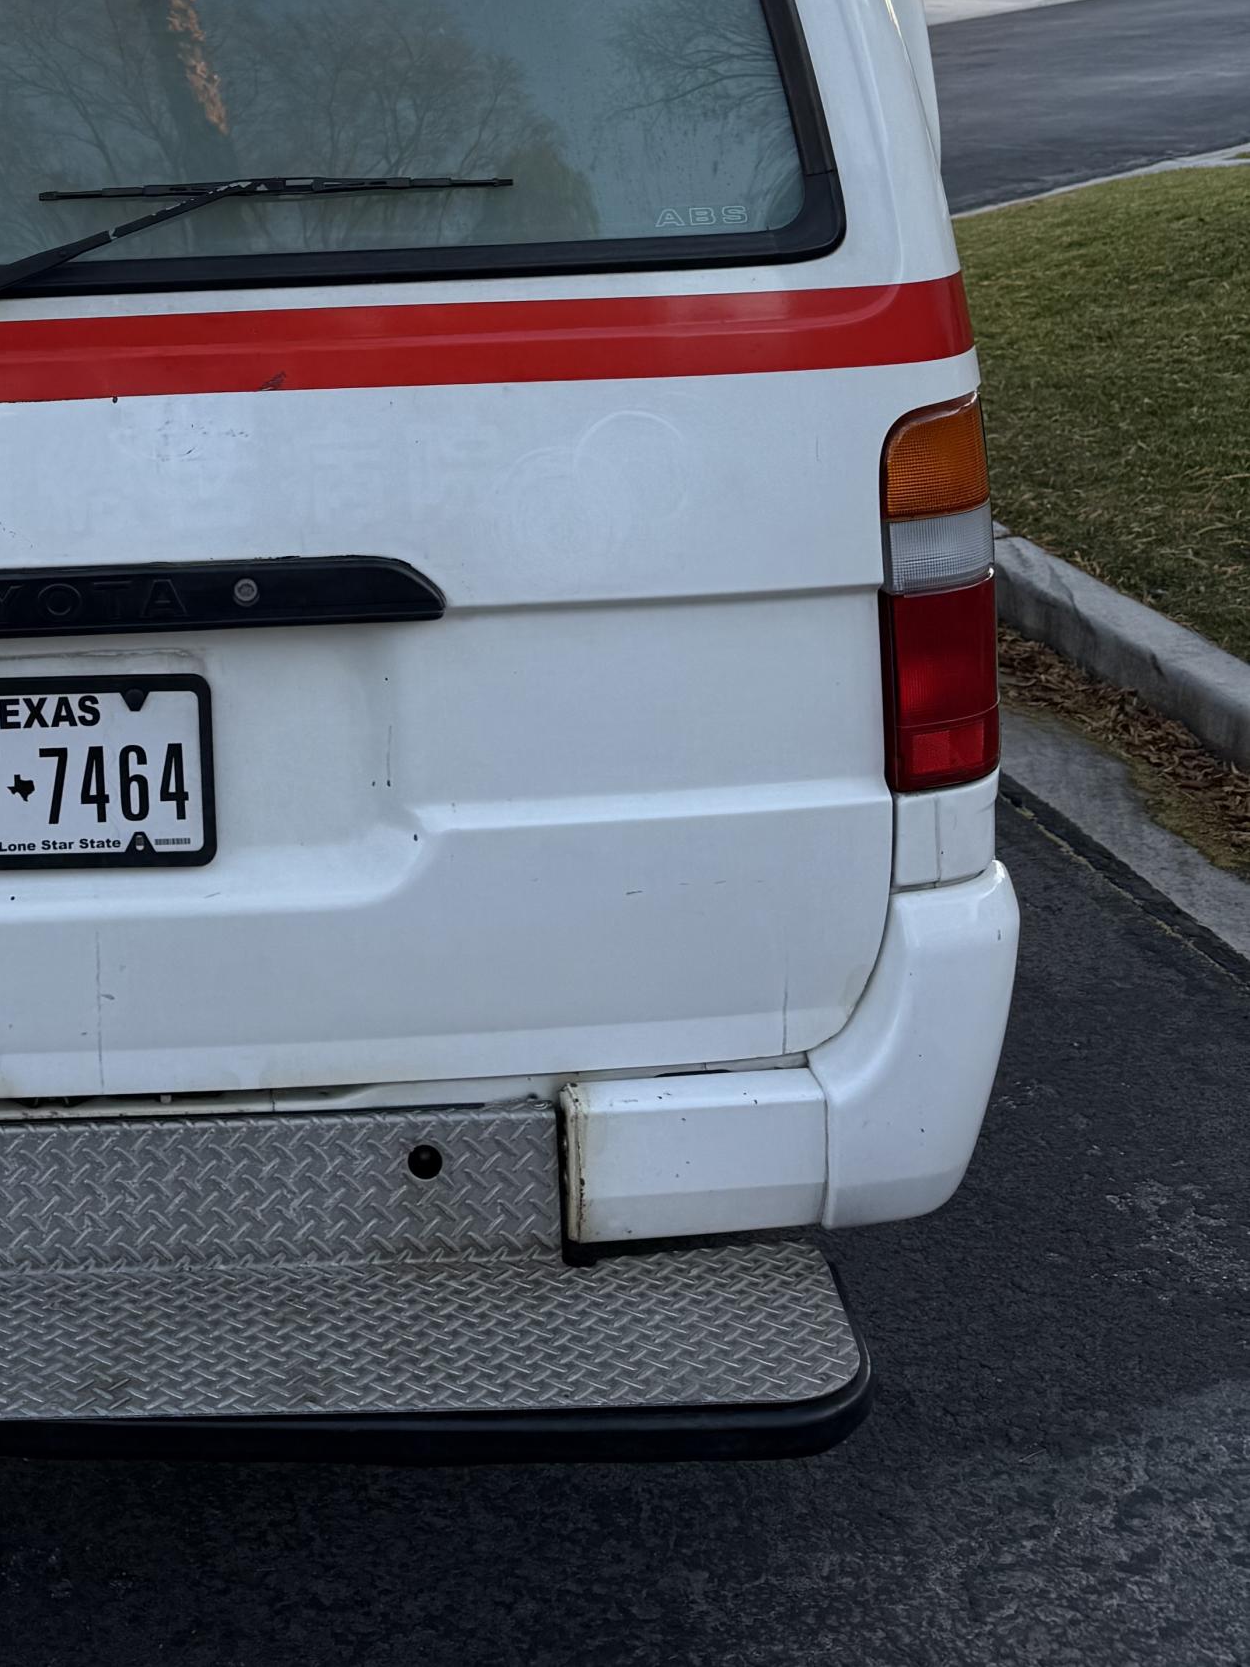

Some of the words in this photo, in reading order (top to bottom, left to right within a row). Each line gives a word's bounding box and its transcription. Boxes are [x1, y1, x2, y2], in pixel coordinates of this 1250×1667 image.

[655, 205, 748, 227] ABS
[39, 742, 189, 825] 7464
[41, 839, 75, 850] Star
[79, 837, 122, 849] State
